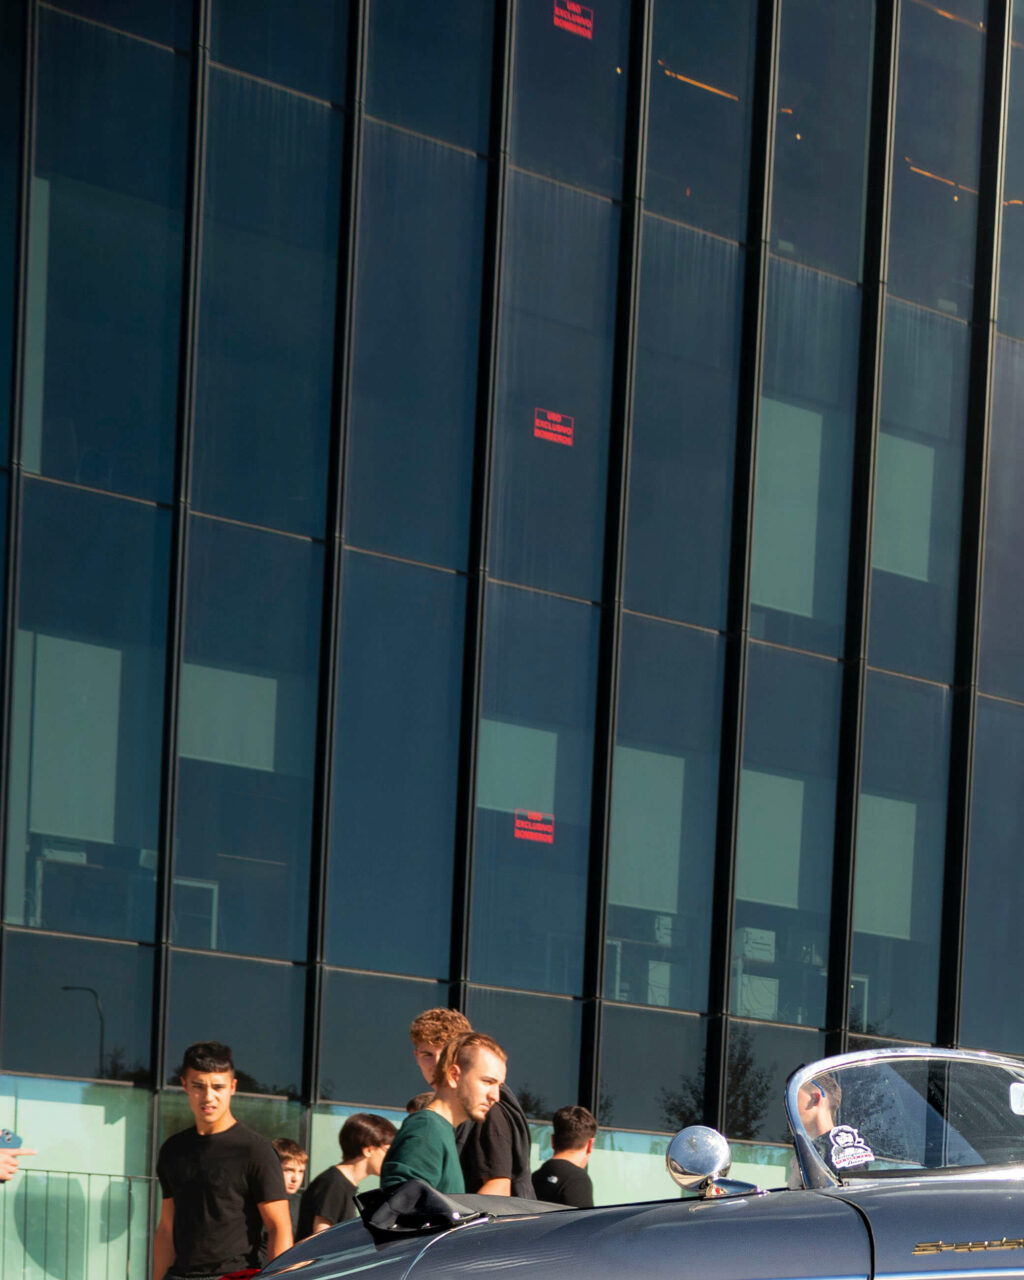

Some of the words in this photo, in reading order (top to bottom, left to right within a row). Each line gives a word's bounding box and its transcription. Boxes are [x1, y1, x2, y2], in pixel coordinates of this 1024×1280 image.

[554, 6, 592, 28] EXCLUSIVO
[535, 418, 573, 435] EXCLUSIVO
[515, 819, 553, 833] EXCLUSIVO
